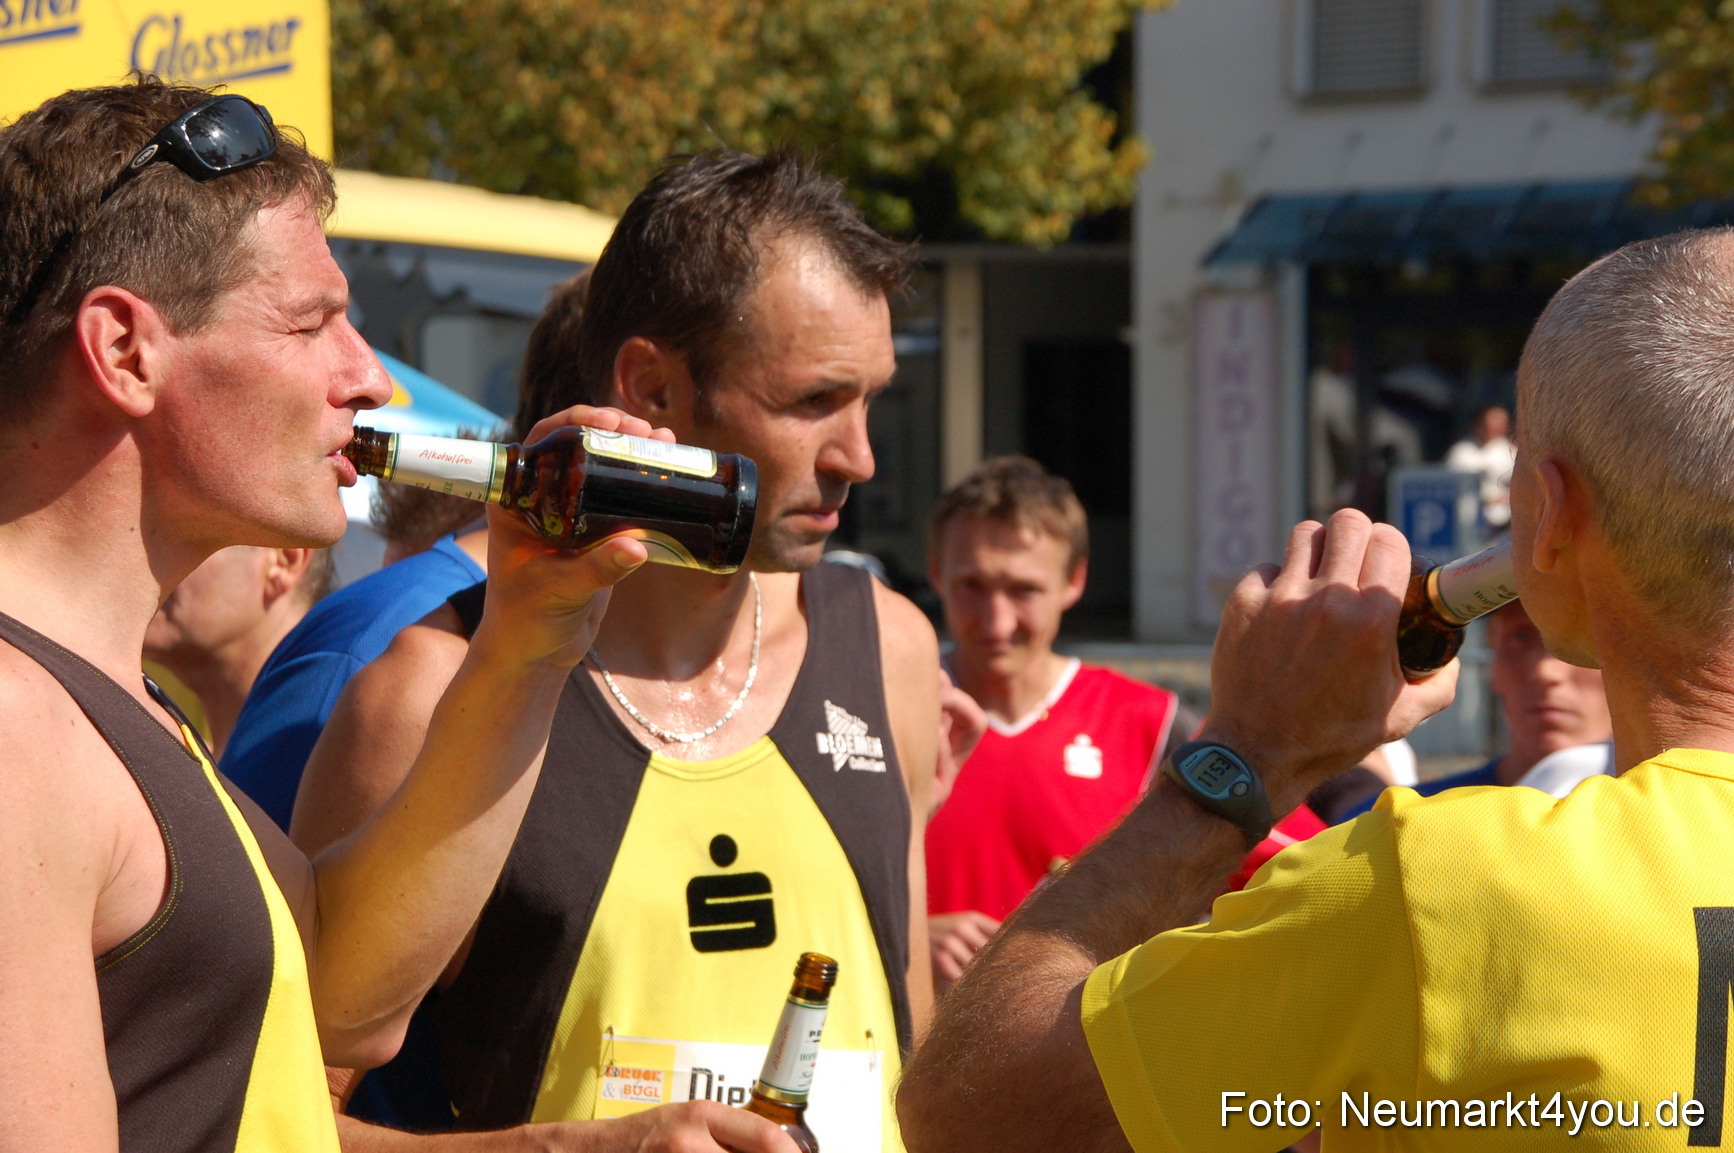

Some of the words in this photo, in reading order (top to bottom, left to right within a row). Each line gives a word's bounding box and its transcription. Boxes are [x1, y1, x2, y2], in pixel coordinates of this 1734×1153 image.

[130, 15, 299, 76] Glossner
[419, 449, 473, 465] Alkoholfrei
[1216, 305, 1256, 566] INDIGO
